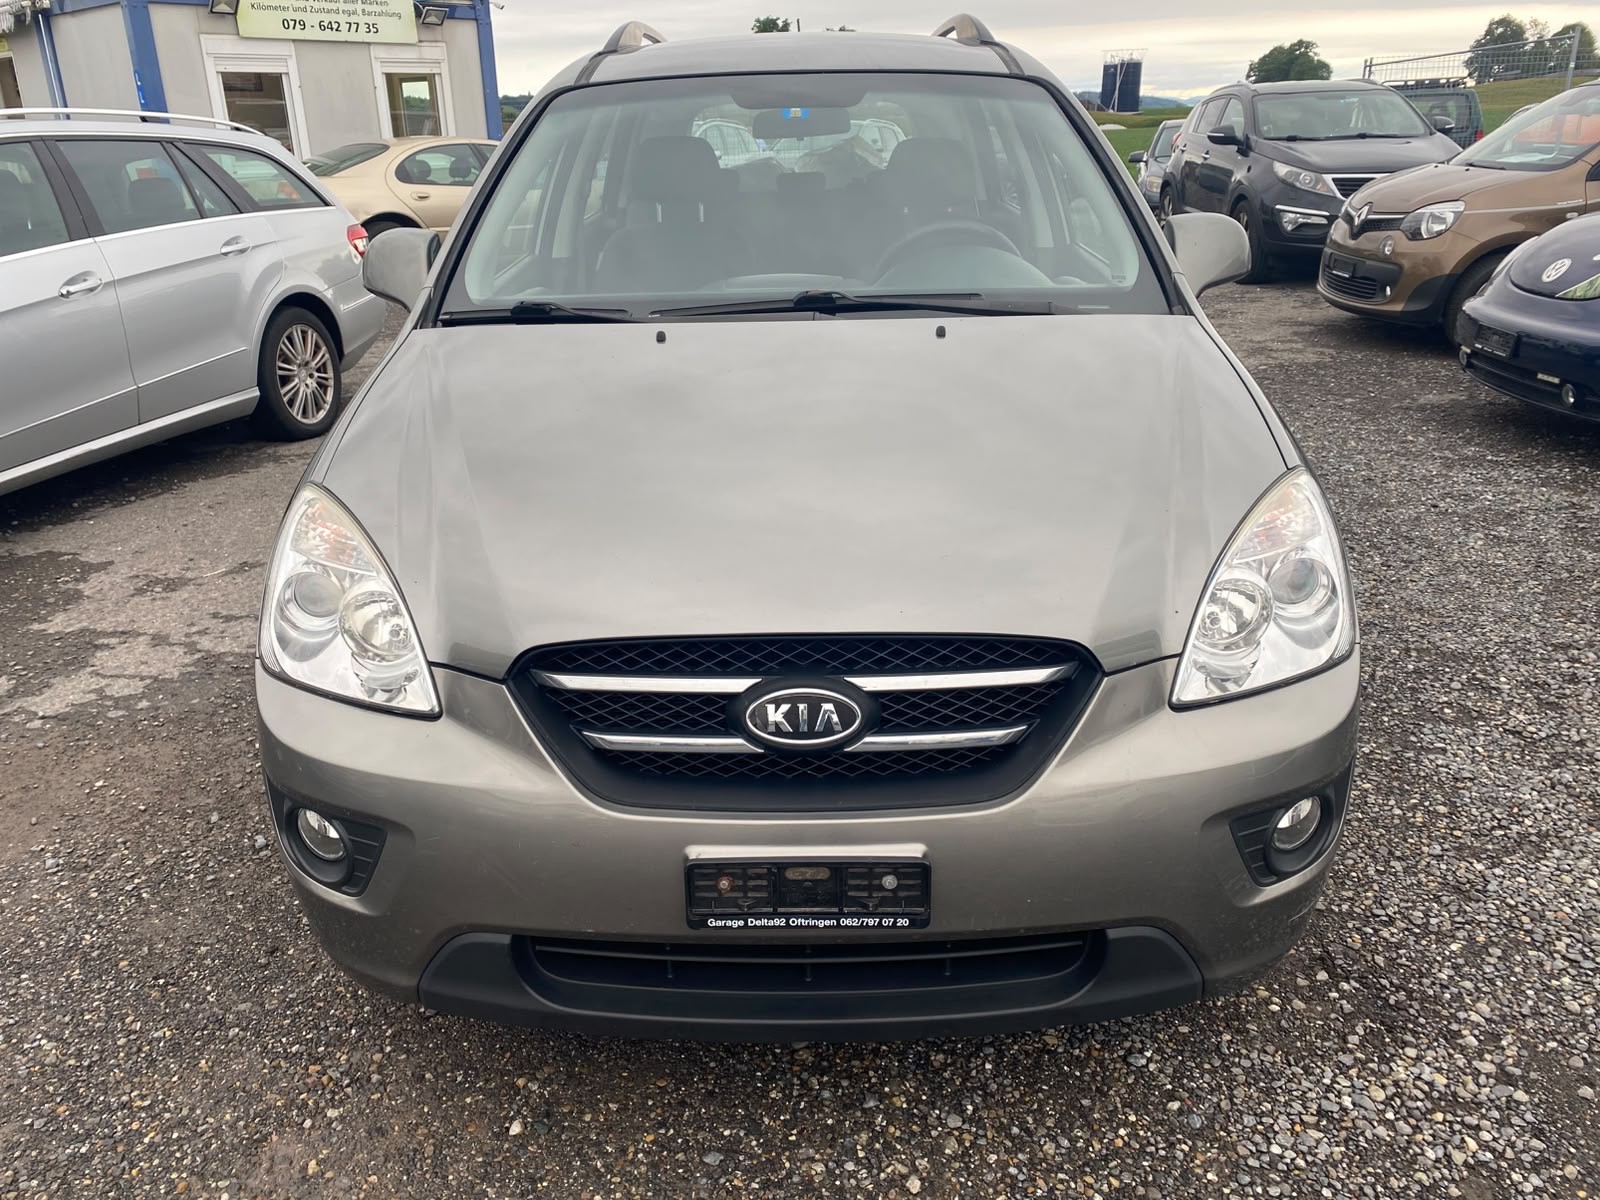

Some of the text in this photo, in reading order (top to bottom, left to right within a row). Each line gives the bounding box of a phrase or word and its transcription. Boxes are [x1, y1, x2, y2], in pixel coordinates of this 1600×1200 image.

[250, 2, 402, 20] Kilometer und Zustand egal, Barzahlung
[282, 18, 306, 31] 079
[318, 20, 342, 32] 642
[345, 21, 360, 33] 77
[363, 22, 379, 34] 35
[764, 703, 843, 733] KIA
[707, 917, 909, 928] Garage Delta92 Oftringen 062/797 07 20
